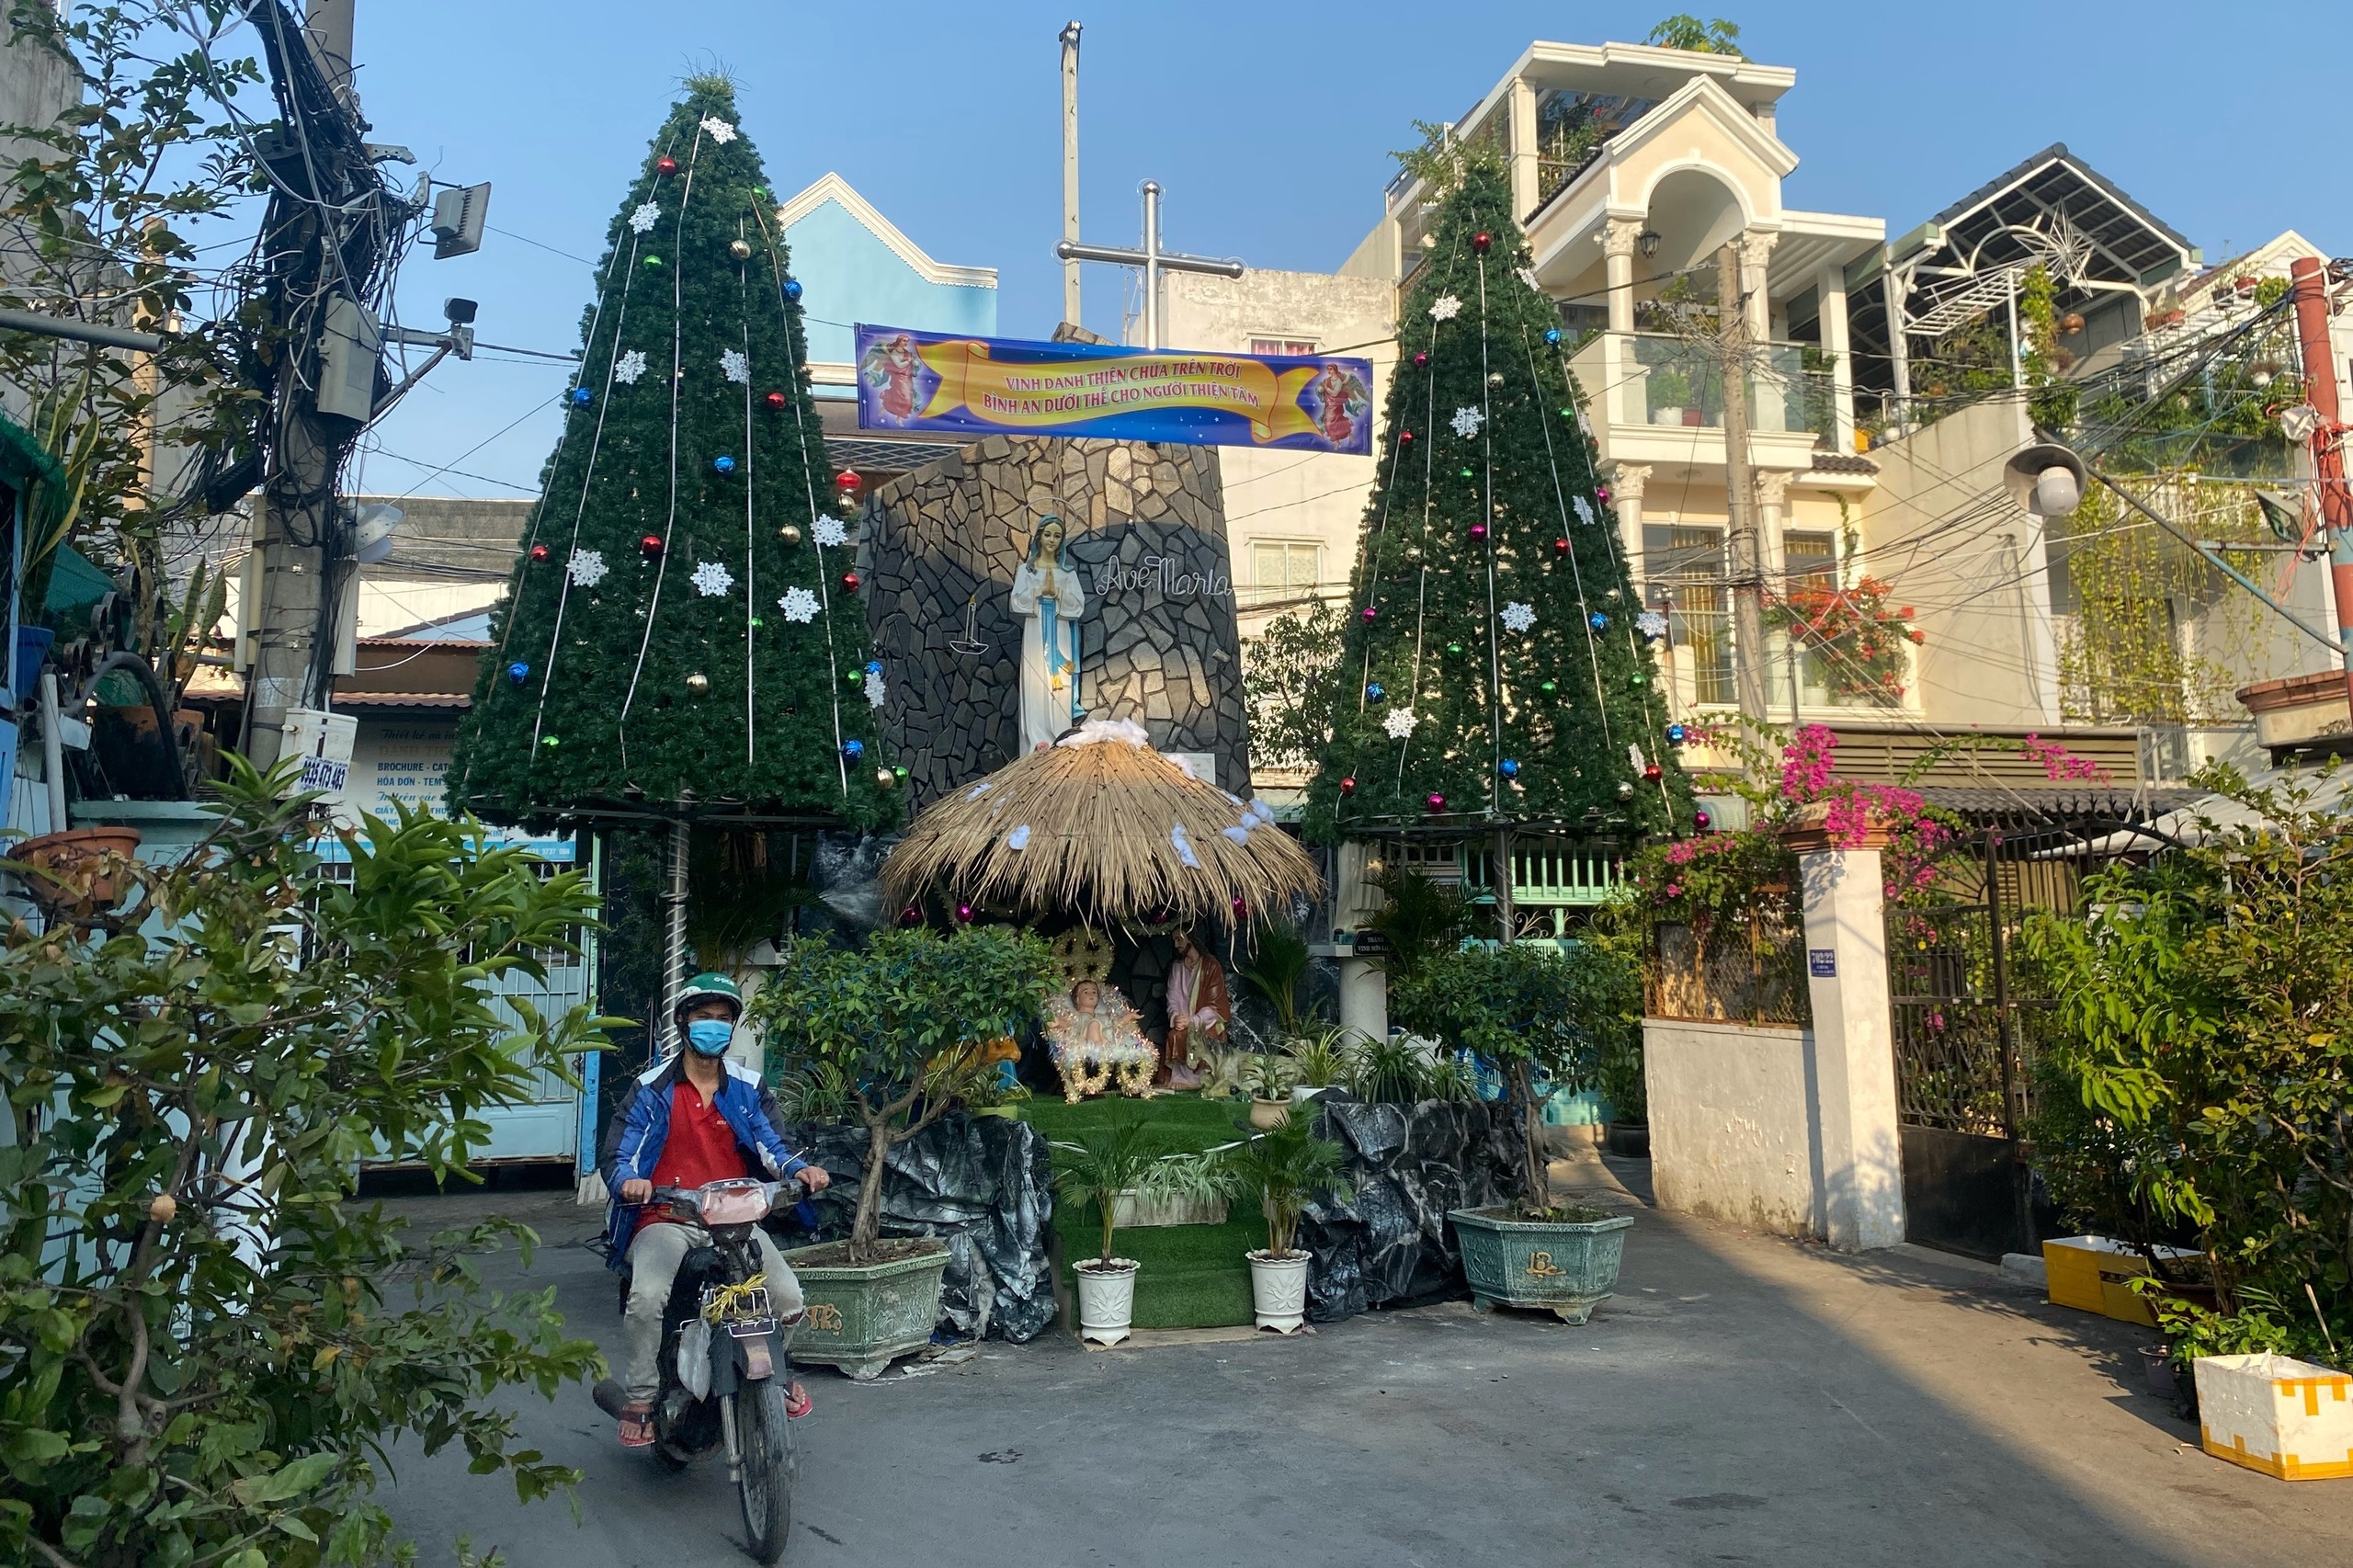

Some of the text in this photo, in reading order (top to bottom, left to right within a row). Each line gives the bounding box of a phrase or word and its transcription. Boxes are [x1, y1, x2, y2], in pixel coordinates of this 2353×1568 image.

[1005, 358, 1241, 392] VINH DANH THIÊN CHÚA TRÊN TRỜI
[983, 381, 1259, 414] BÌNH AN DƯỚI THẾ CHO NGƯỜI THIỆN TÂM
[378, 762, 425, 772] BROCHURE
[377, 776, 394, 786] HÓA
